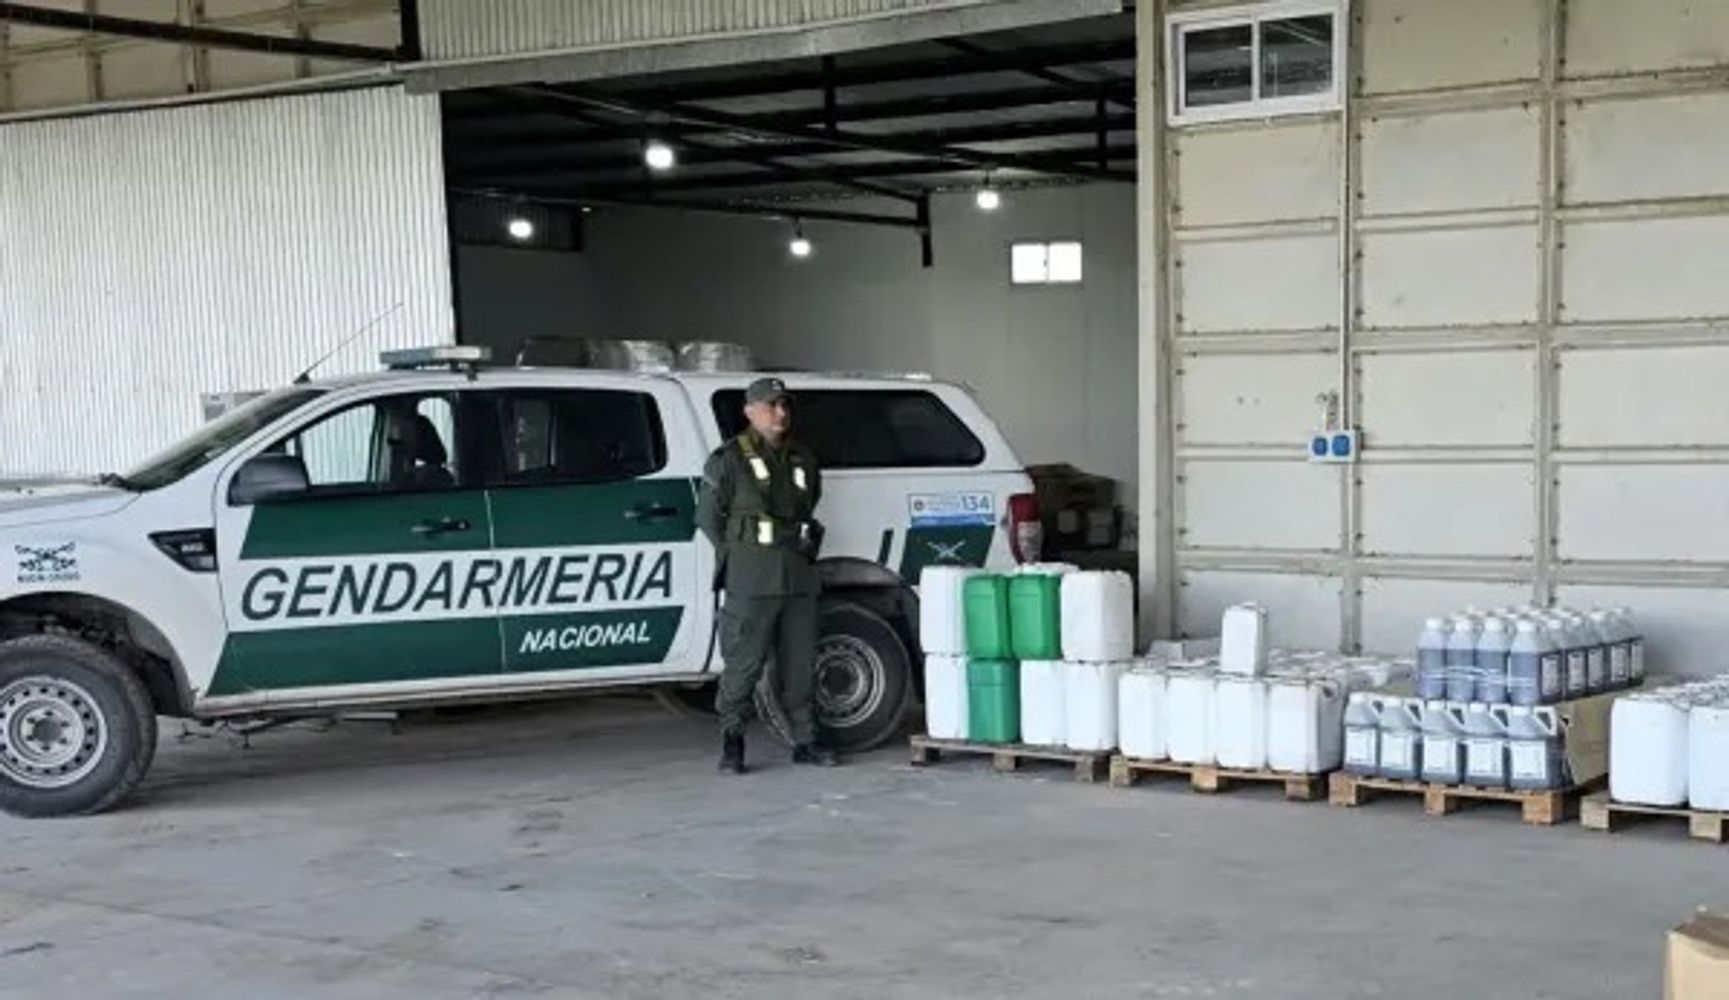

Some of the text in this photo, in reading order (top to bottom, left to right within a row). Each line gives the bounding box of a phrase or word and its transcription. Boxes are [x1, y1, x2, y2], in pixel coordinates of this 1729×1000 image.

[961, 495, 990, 511] 134
[241, 550, 673, 621] GENDARMERIA
[519, 620, 652, 654] NACIONAL
